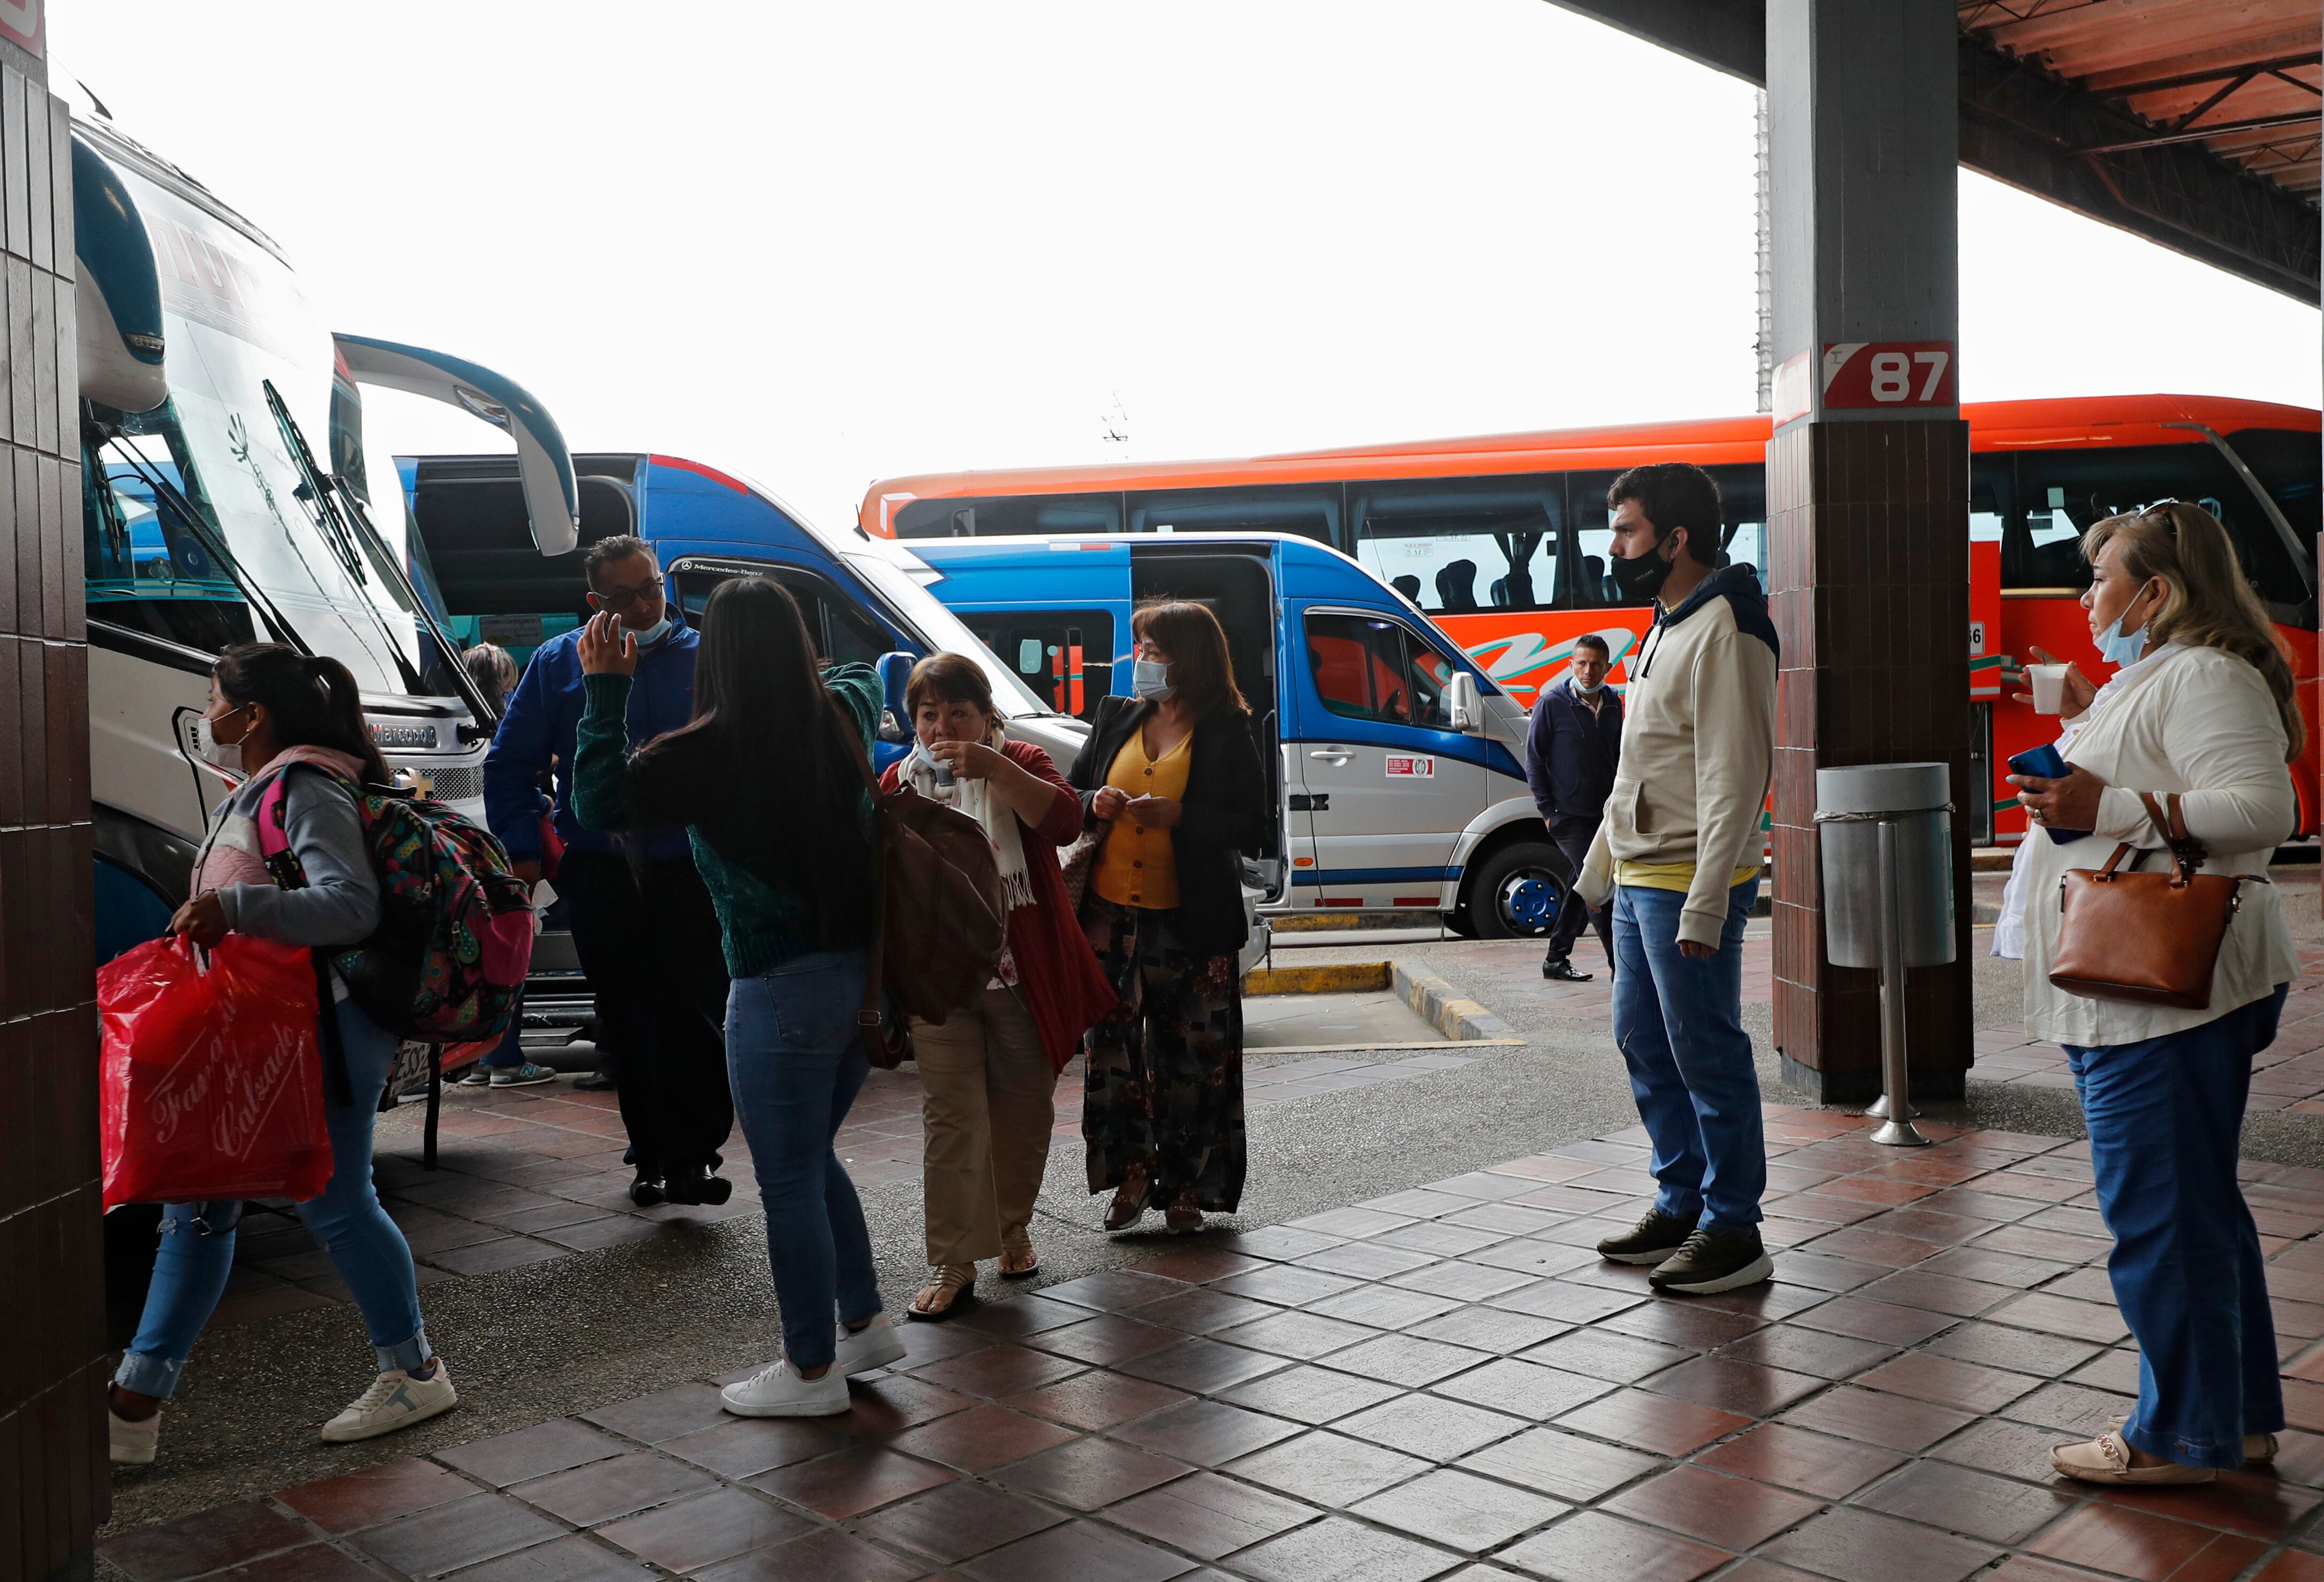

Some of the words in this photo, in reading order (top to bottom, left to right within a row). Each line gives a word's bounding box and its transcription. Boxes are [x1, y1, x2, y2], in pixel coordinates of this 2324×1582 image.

[1870, 351, 1949, 402] 87
[693, 563, 764, 577] Mercedes-Benz
[368, 723, 436, 746] Marcopolo
